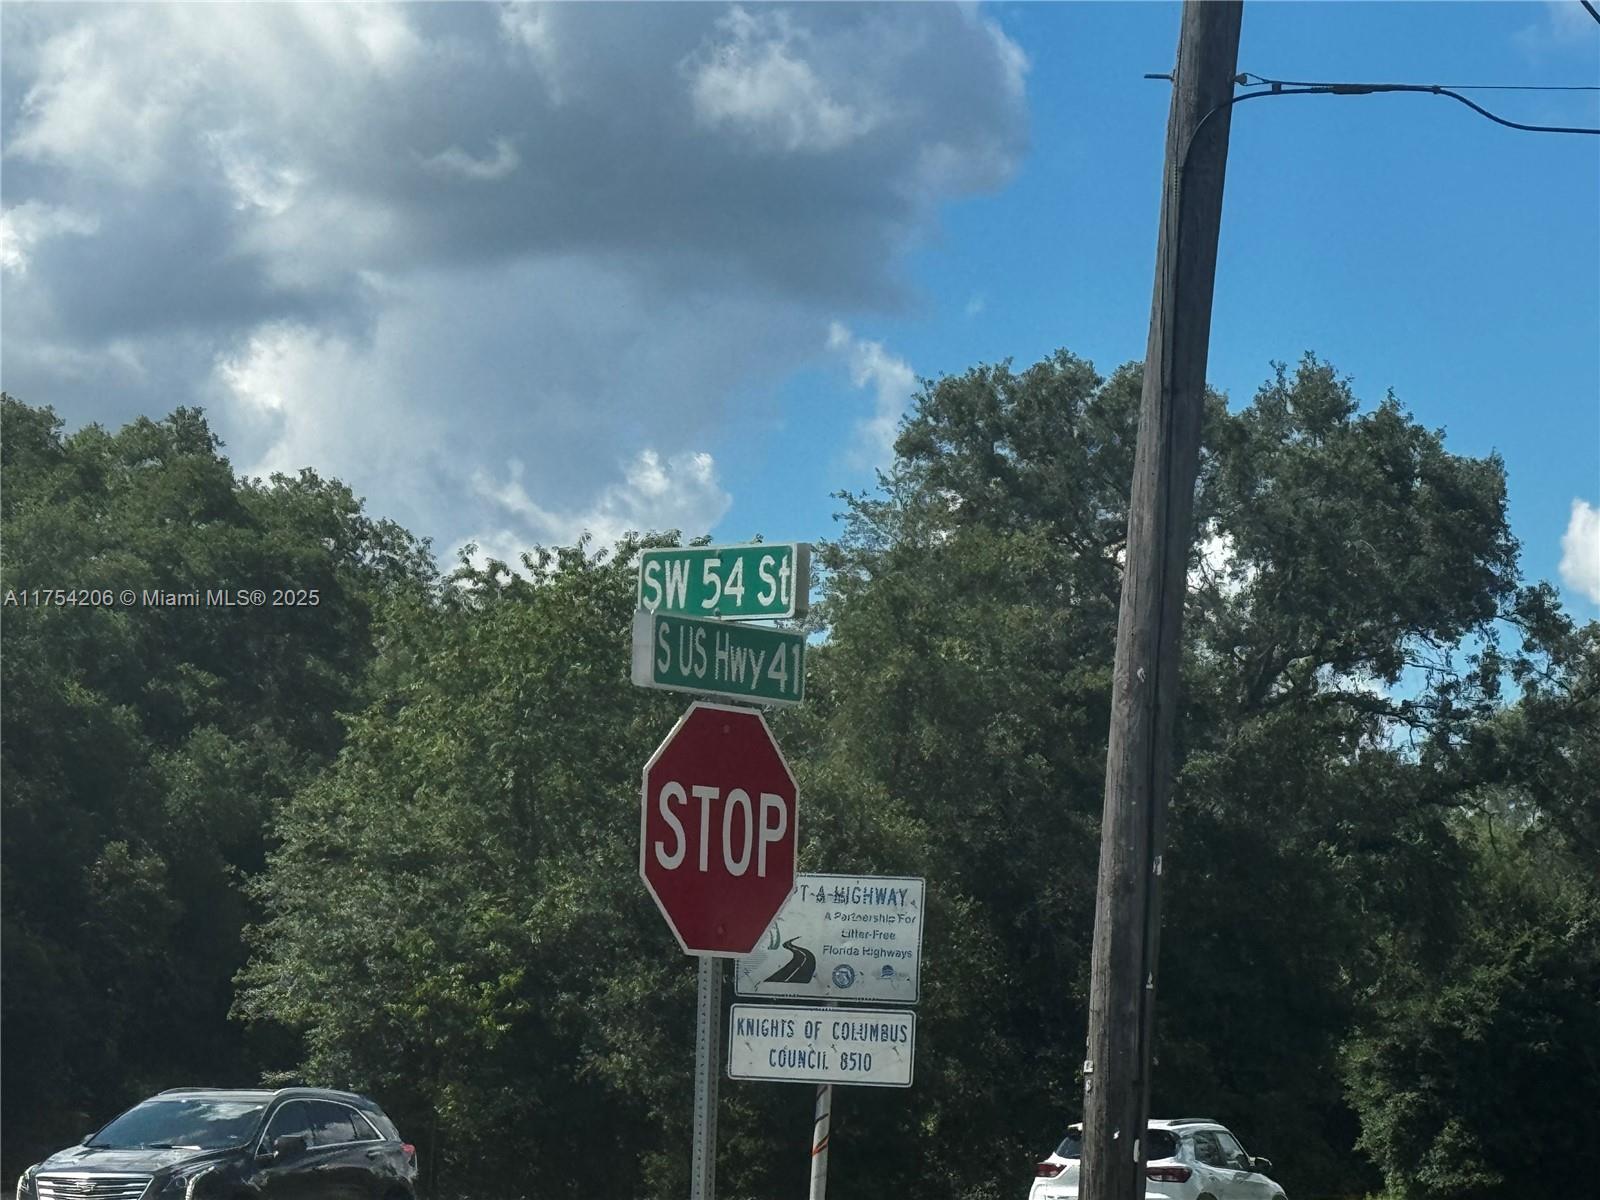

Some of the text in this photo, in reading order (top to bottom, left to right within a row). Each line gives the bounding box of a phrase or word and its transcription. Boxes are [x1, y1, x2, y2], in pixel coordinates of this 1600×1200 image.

[643, 554, 791, 609] SW 54 St
[657, 622, 800, 695] S US Hwy 41
[655, 781, 788, 878] STOP
[824, 911, 917, 924] A Partnership For
[841, 929, 897, 940] Litter-Free
[822, 945, 914, 960] Florida Highways
[736, 1018, 908, 1043] KNIGHTS OF COLUMBUS
[769, 1049, 872, 1072] COUNCIL 8510
